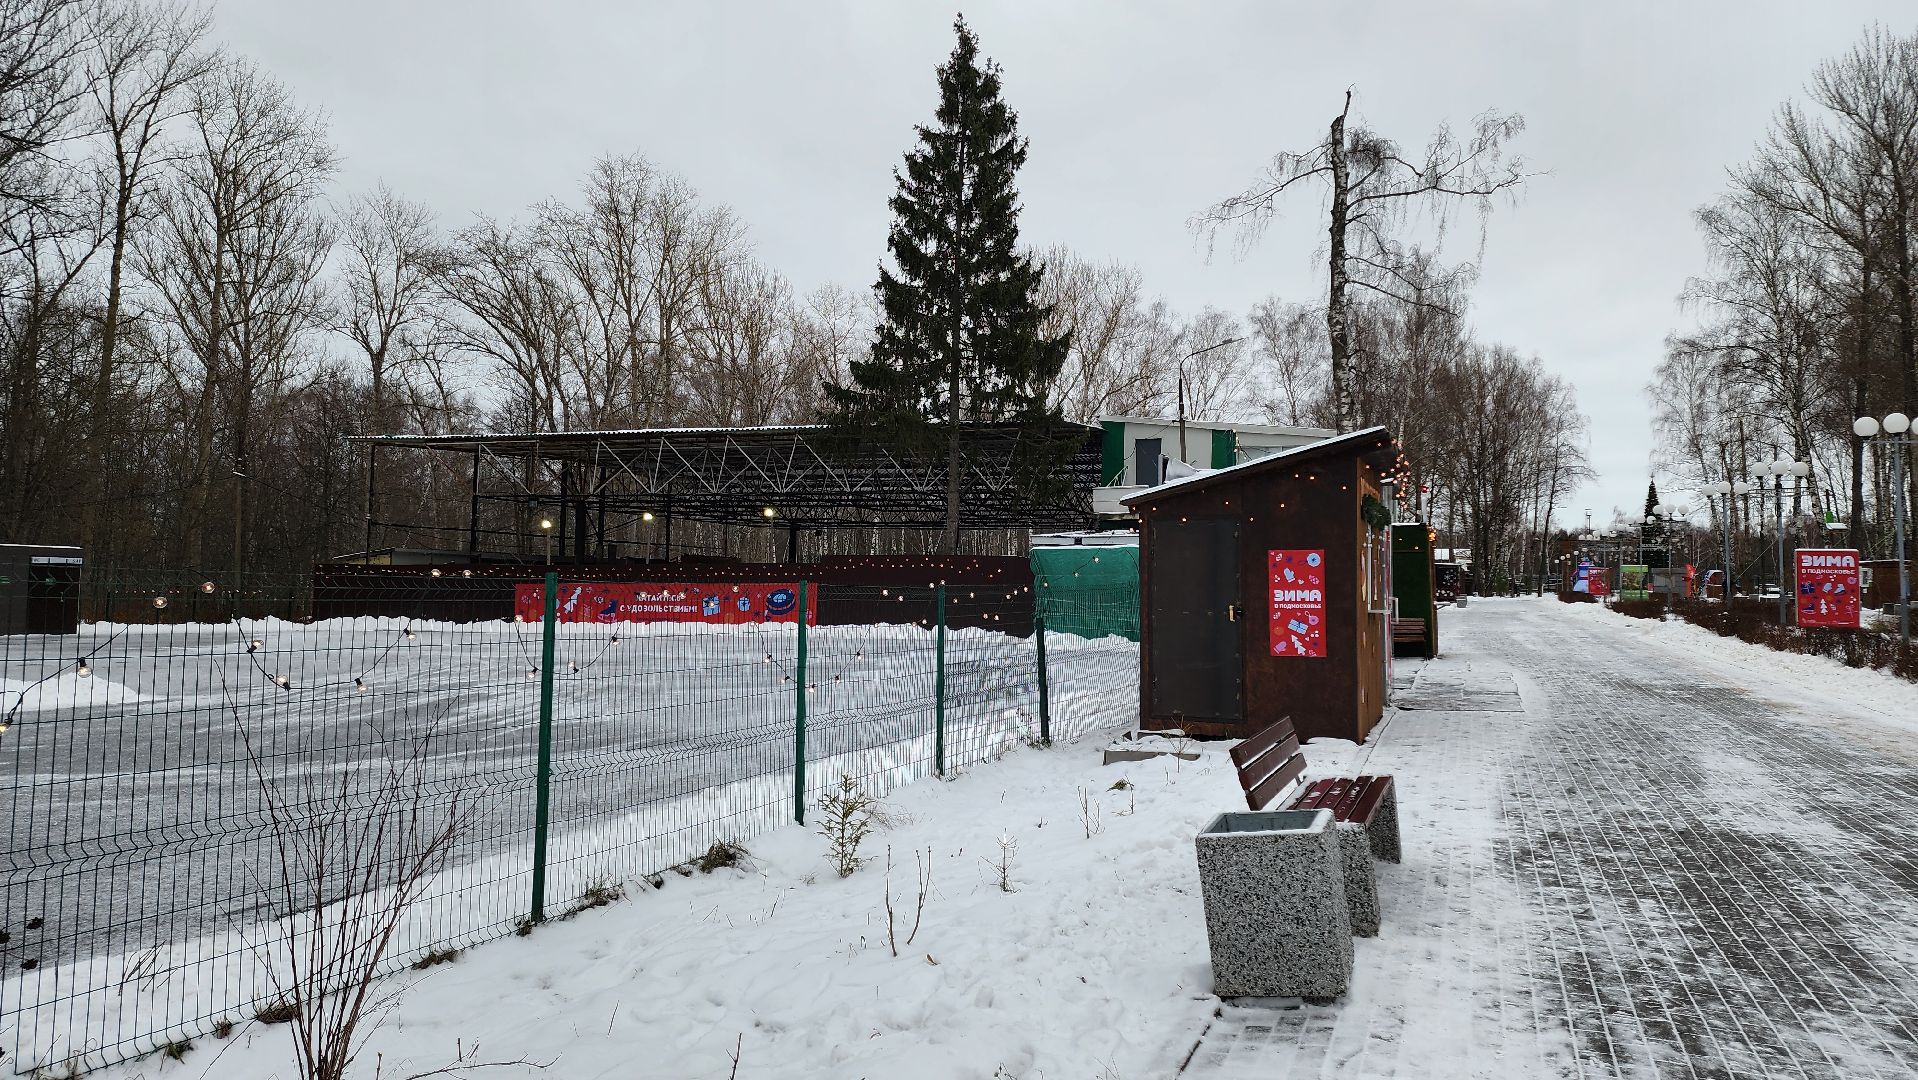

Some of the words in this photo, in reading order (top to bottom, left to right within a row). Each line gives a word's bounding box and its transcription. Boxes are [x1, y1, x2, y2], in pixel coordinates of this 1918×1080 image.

[1801, 555, 1855, 567] ЗИМА
[1273, 589, 1322, 602] ЗИМА
[627, 605, 698, 613] УДОВОЛЬСТВИЕМ!
